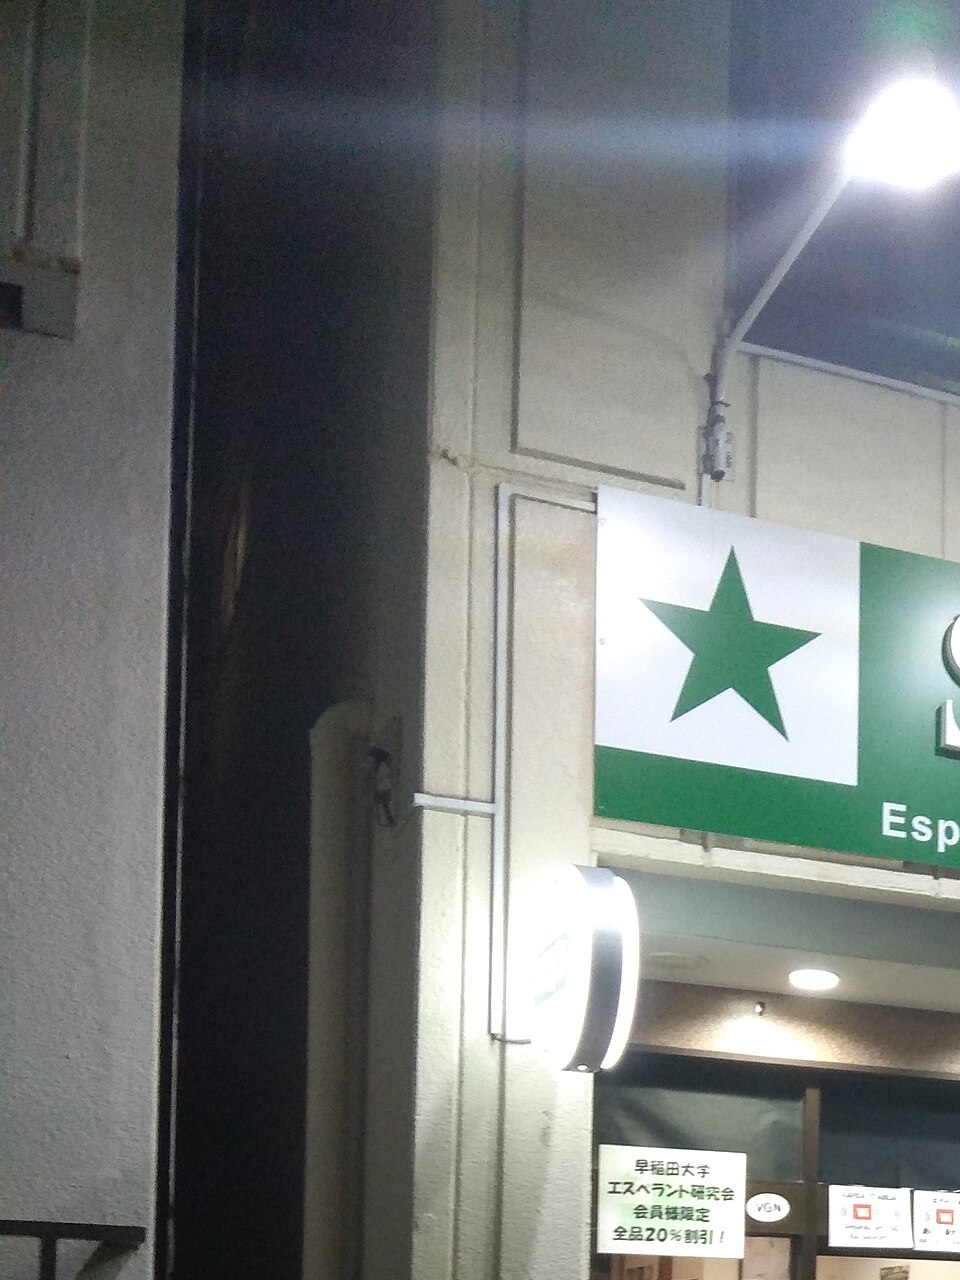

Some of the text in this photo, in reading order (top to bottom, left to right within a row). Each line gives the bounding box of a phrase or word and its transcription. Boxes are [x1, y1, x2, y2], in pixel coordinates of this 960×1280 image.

[634, 1159, 711, 1178] 早稲田大学
[607, 1181, 735, 1201] エスペラント研究会
[633, 1204, 711, 1222] 会員様限定
[756, 1202, 781, 1213] VGN
